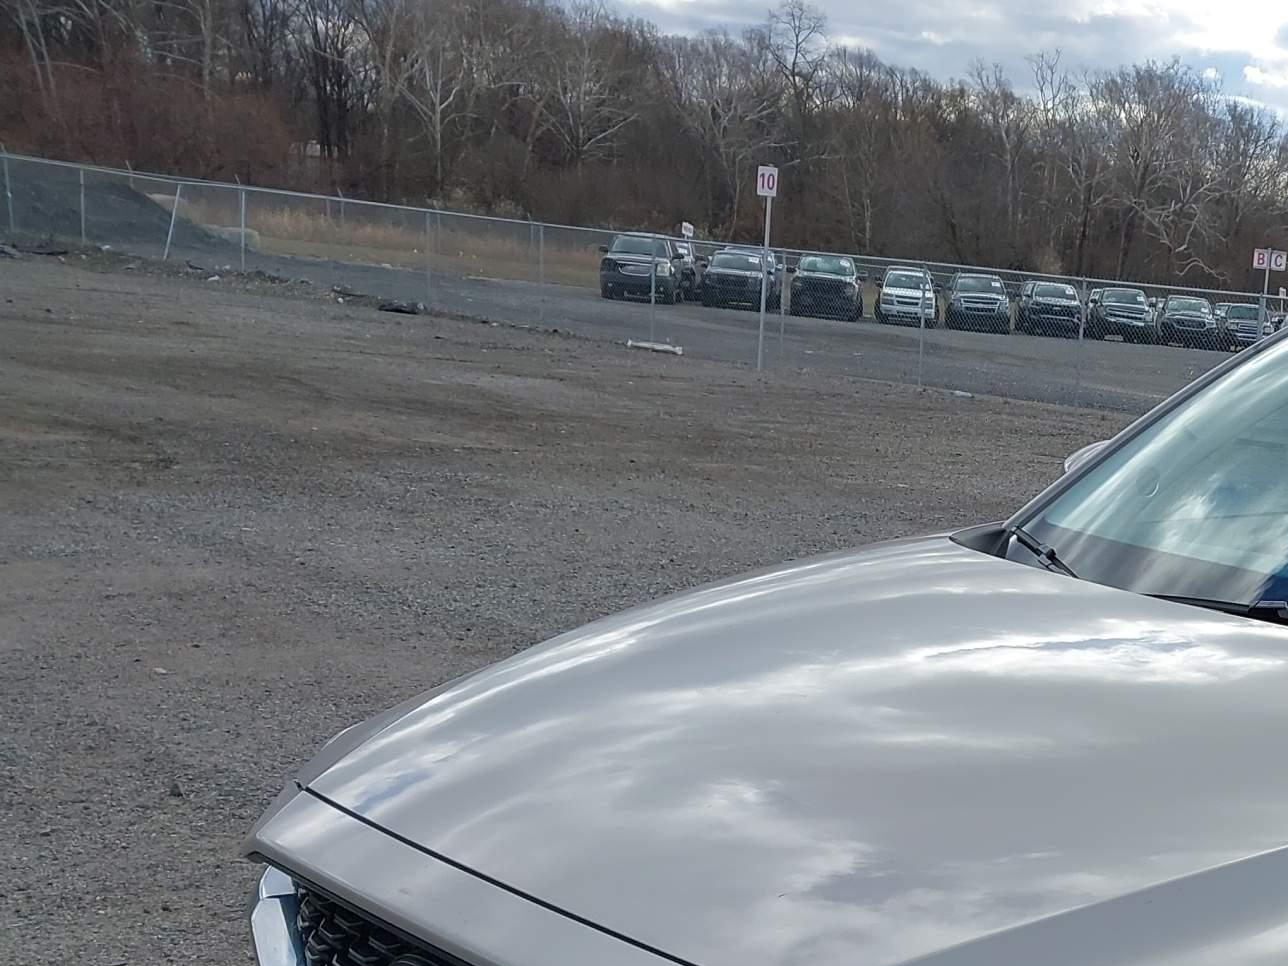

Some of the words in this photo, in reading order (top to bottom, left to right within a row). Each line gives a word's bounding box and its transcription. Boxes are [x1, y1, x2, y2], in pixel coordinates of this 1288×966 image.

[760, 172, 775, 190] 10
[1257, 253, 1265, 266] B
[1275, 255, 1283, 268] C
